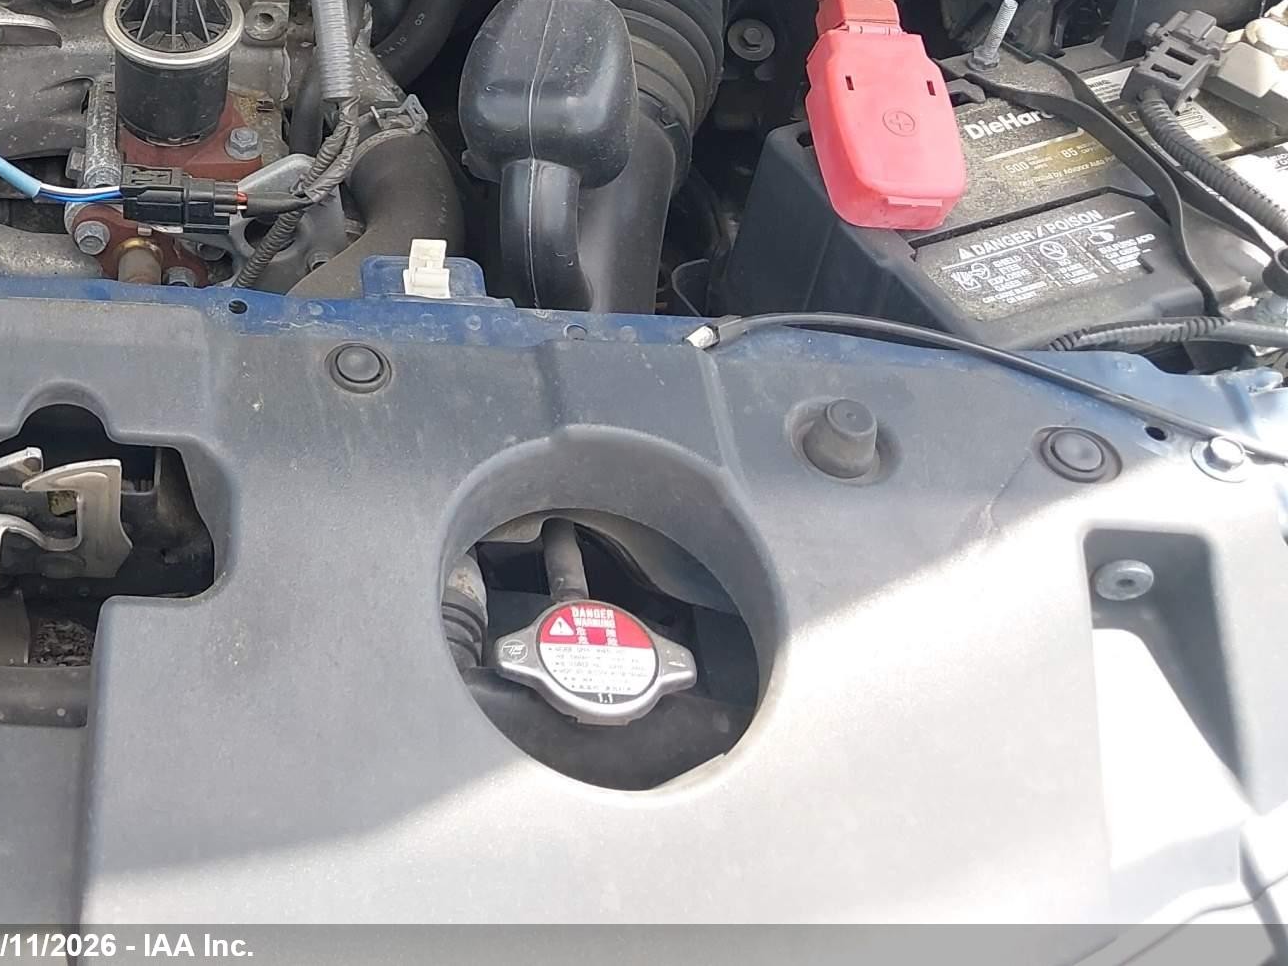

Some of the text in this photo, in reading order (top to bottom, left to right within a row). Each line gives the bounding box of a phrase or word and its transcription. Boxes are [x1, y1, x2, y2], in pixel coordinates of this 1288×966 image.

[1004, 161, 1031, 175] 500
[971, 225, 1036, 257] DANGER
[1044, 209, 1104, 235] POISON
[571, 607, 614, 620] DANGER
[596, 693, 613, 705] 1.1
